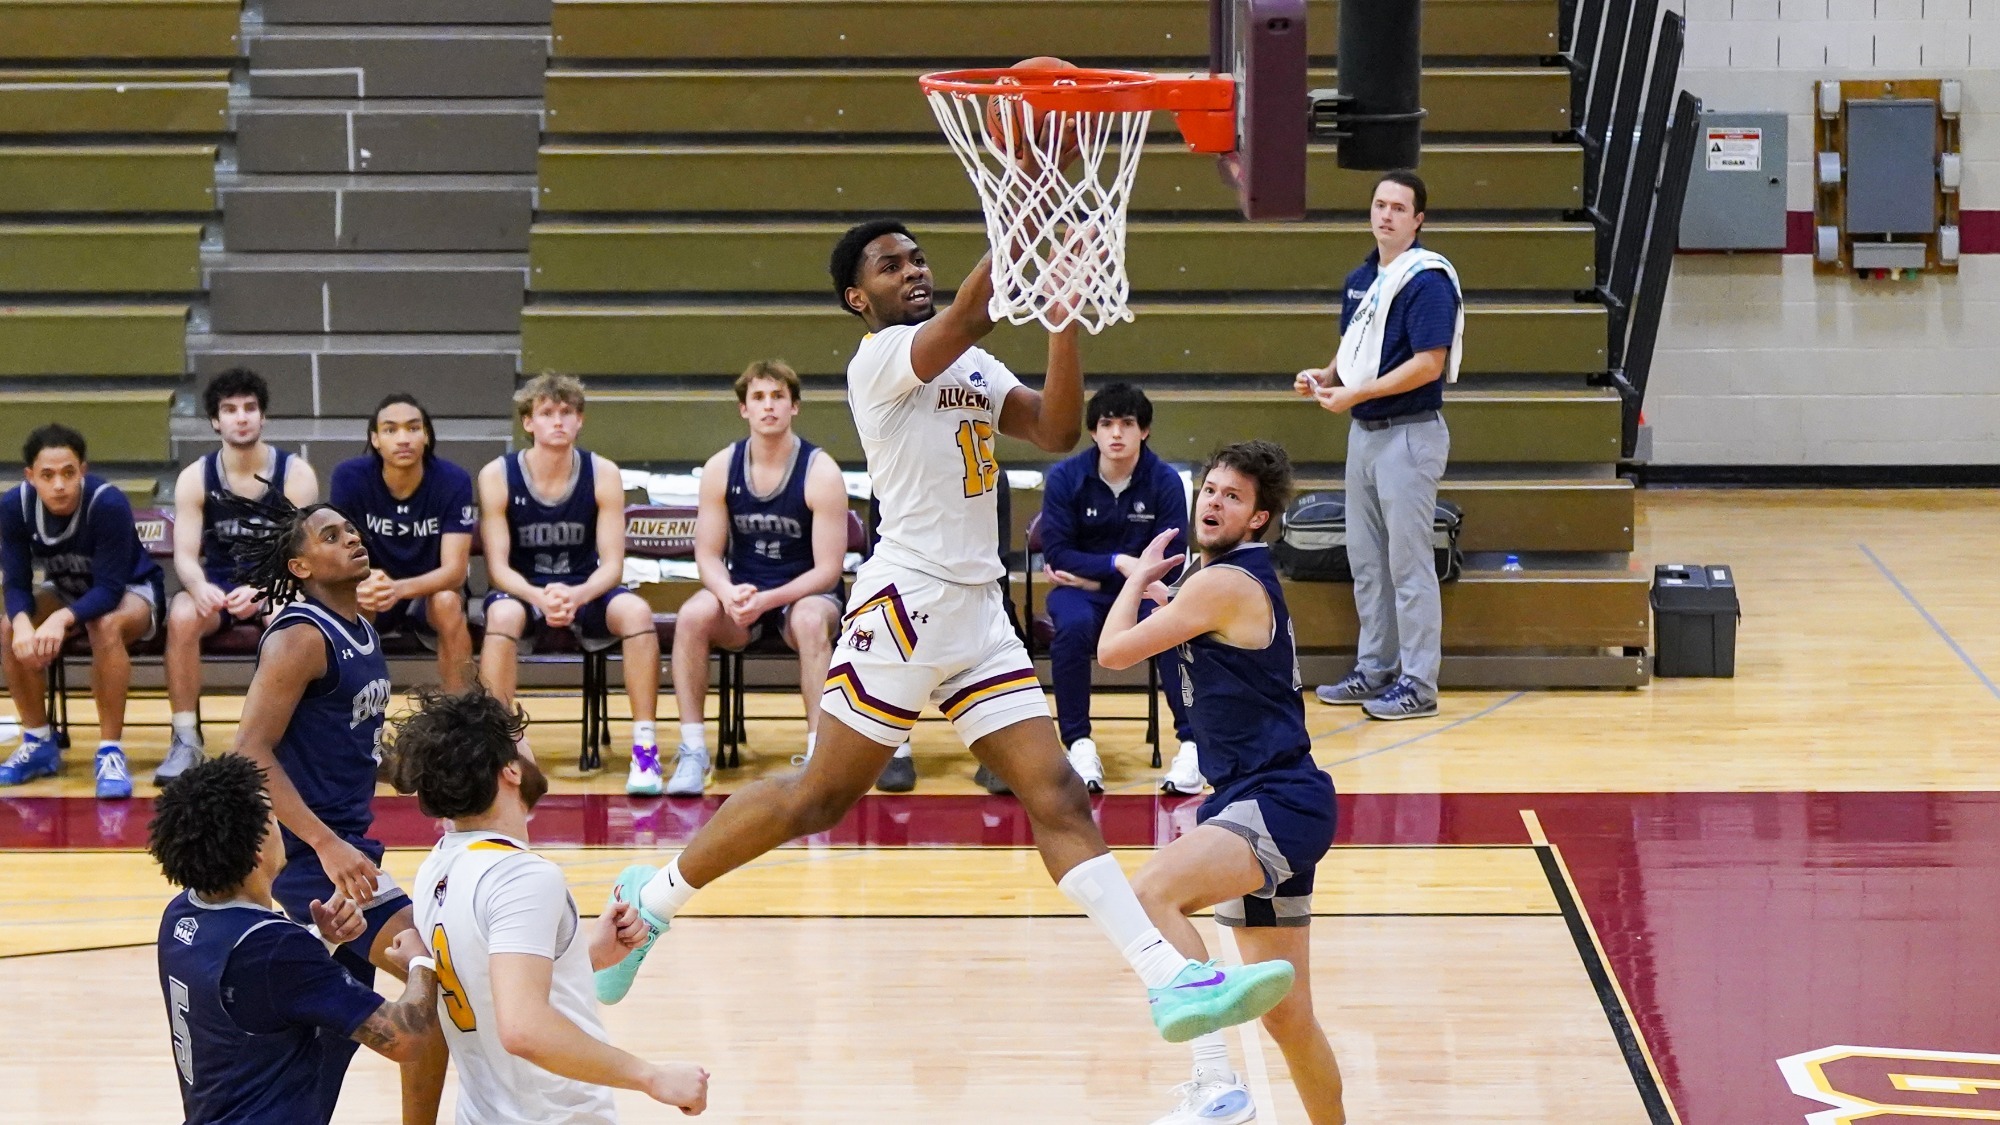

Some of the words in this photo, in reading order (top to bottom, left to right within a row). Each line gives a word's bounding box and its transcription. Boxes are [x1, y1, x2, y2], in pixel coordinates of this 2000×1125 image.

[366, 513, 393, 537] WE
[397, 522, 409, 536] >
[413, 517, 439, 538] ME
[517, 520, 586, 548] HOOD
[629, 521, 696, 536] ALVERNI
[350, 678, 391, 730] HOO
[175, 925, 193, 942] MAC
[168, 975, 193, 1086] 5
